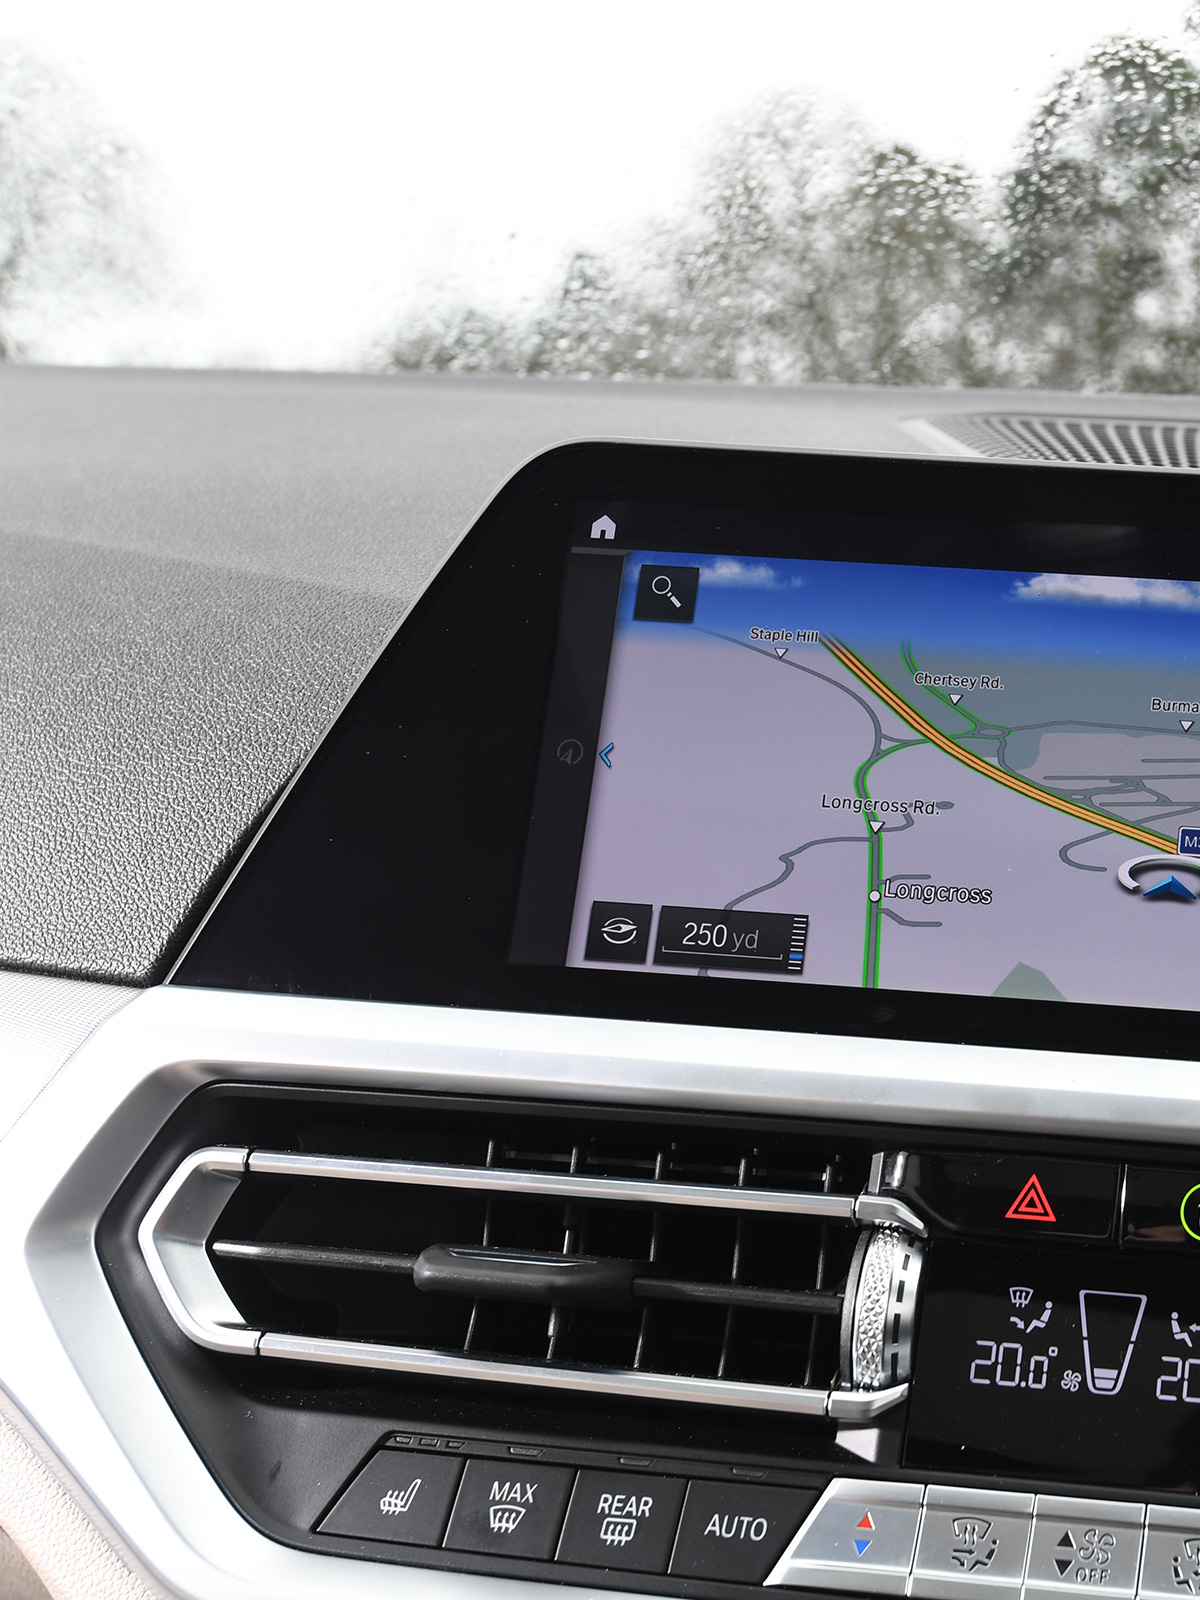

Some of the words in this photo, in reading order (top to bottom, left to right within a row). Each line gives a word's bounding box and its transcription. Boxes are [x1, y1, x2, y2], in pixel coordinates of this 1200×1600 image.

[750, 628, 793, 642] Staple
[796, 630, 819, 643] Hill
[914, 672, 978, 689] Chertsey
[980, 676, 1004, 690] Rd.
[1151, 699, 1199, 714] Burma
[821, 794, 908, 813] Longcross
[913, 800, 940, 815] Rd.
[884, 879, 992, 904] Longcross
[682, 922, 728, 947] 250
[731, 930, 760, 952] yd
[489, 1481, 538, 1504] MAX
[597, 1494, 653, 1518] REAR
[704, 1514, 768, 1542] AUTO
[1075, 1567, 1111, 1585] OFF
